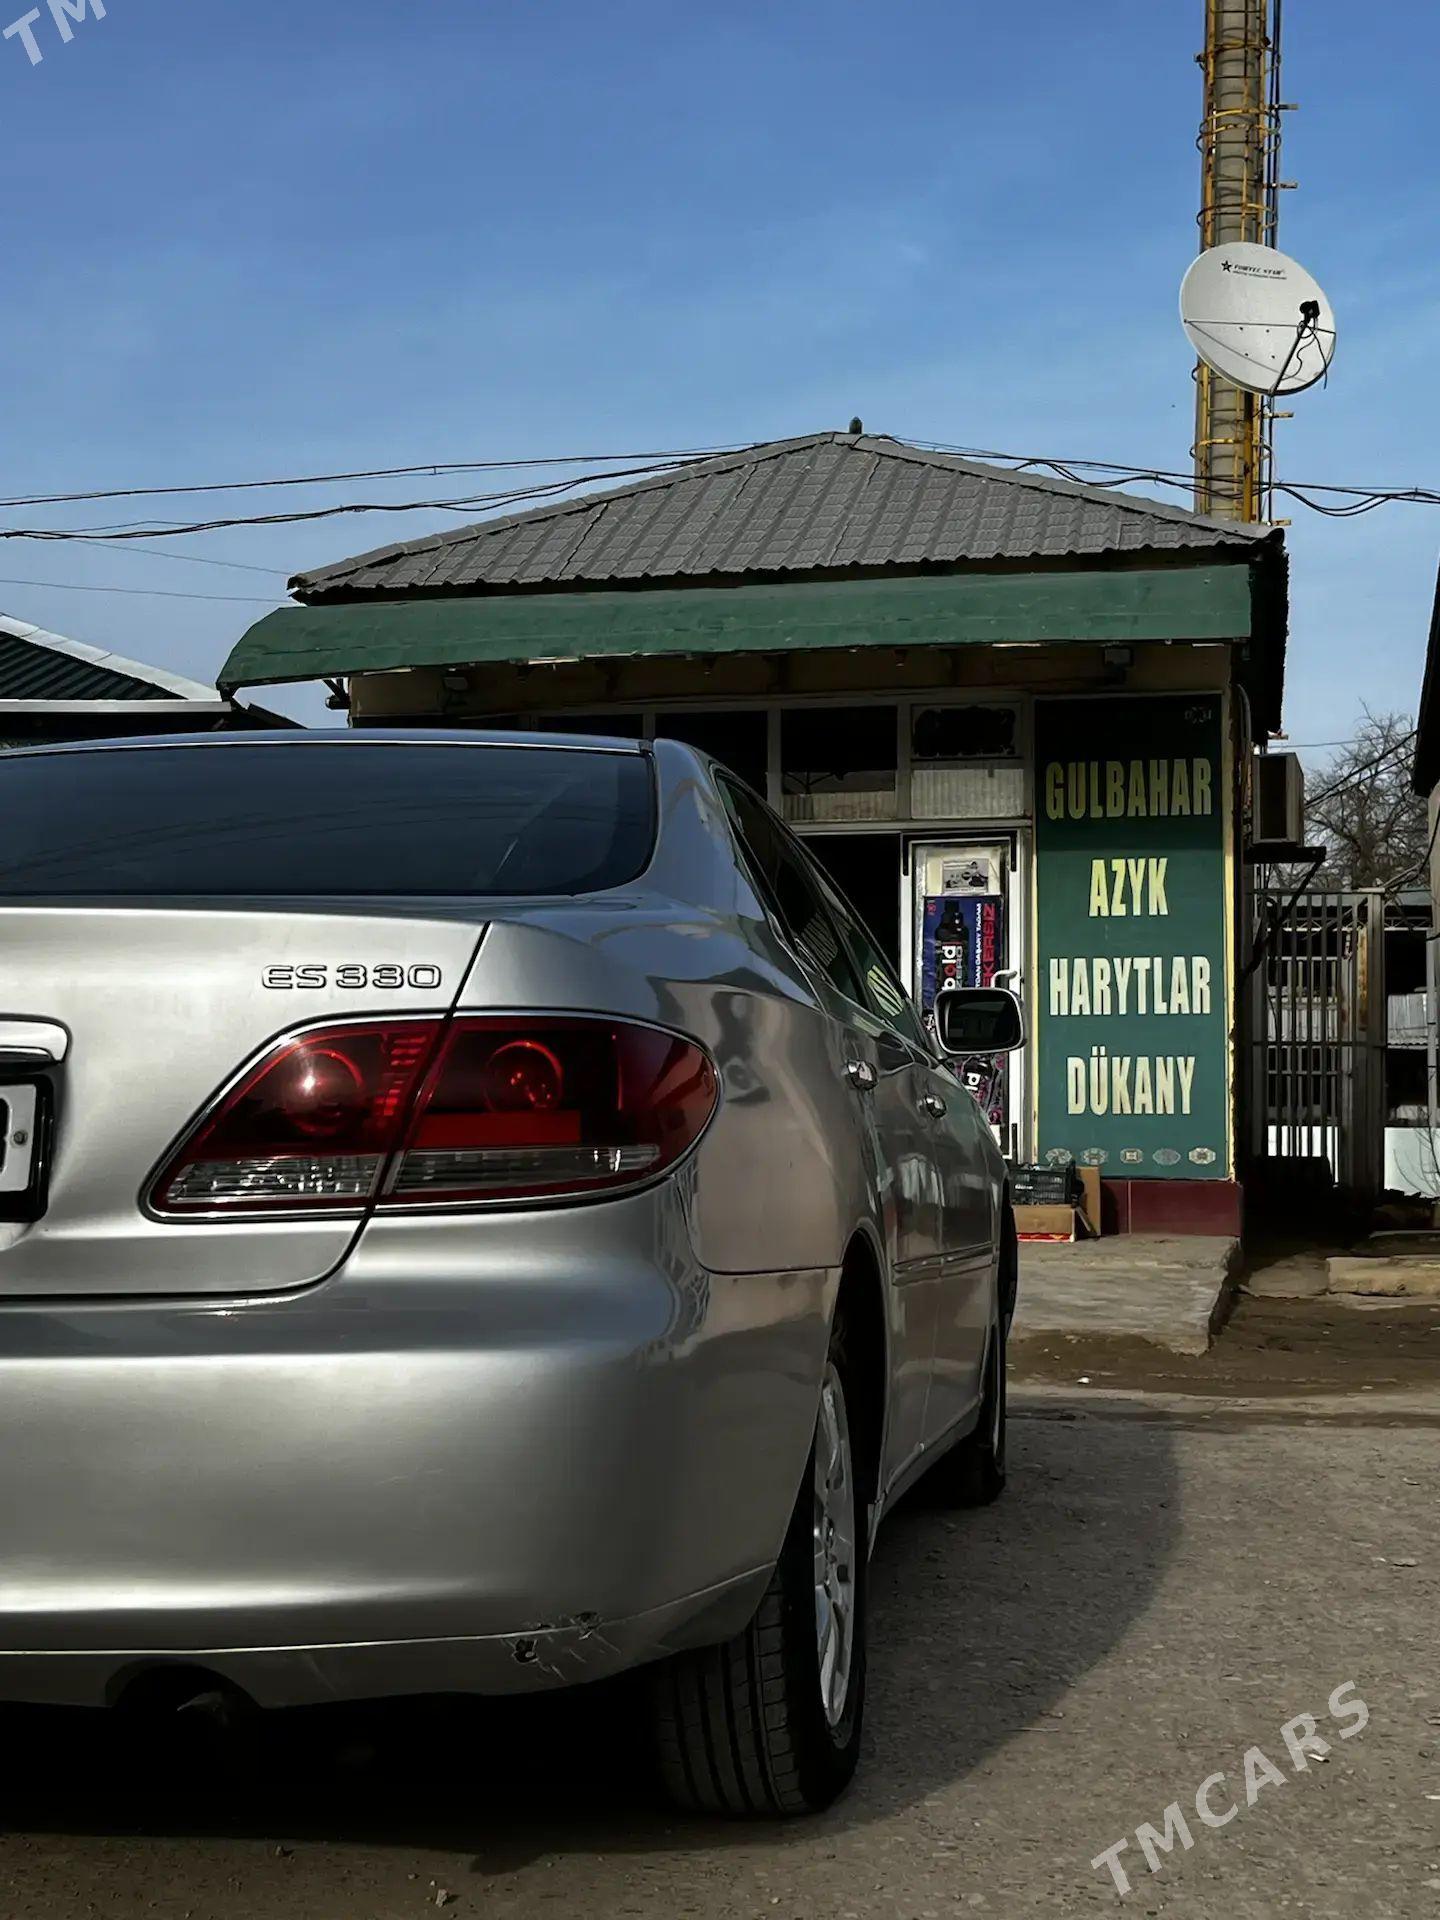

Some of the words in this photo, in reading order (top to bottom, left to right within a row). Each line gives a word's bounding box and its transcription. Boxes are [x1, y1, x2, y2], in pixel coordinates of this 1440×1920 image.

[1045, 757, 1212, 820] GULBAHAR
[1089, 857, 1169, 917] AZYK
[941, 945, 957, 990] bold
[982, 903, 996, 988] KERSIZ
[1049, 955, 1211, 1016] HARYTLAR
[1066, 1045, 1196, 1116] DÜKANY
